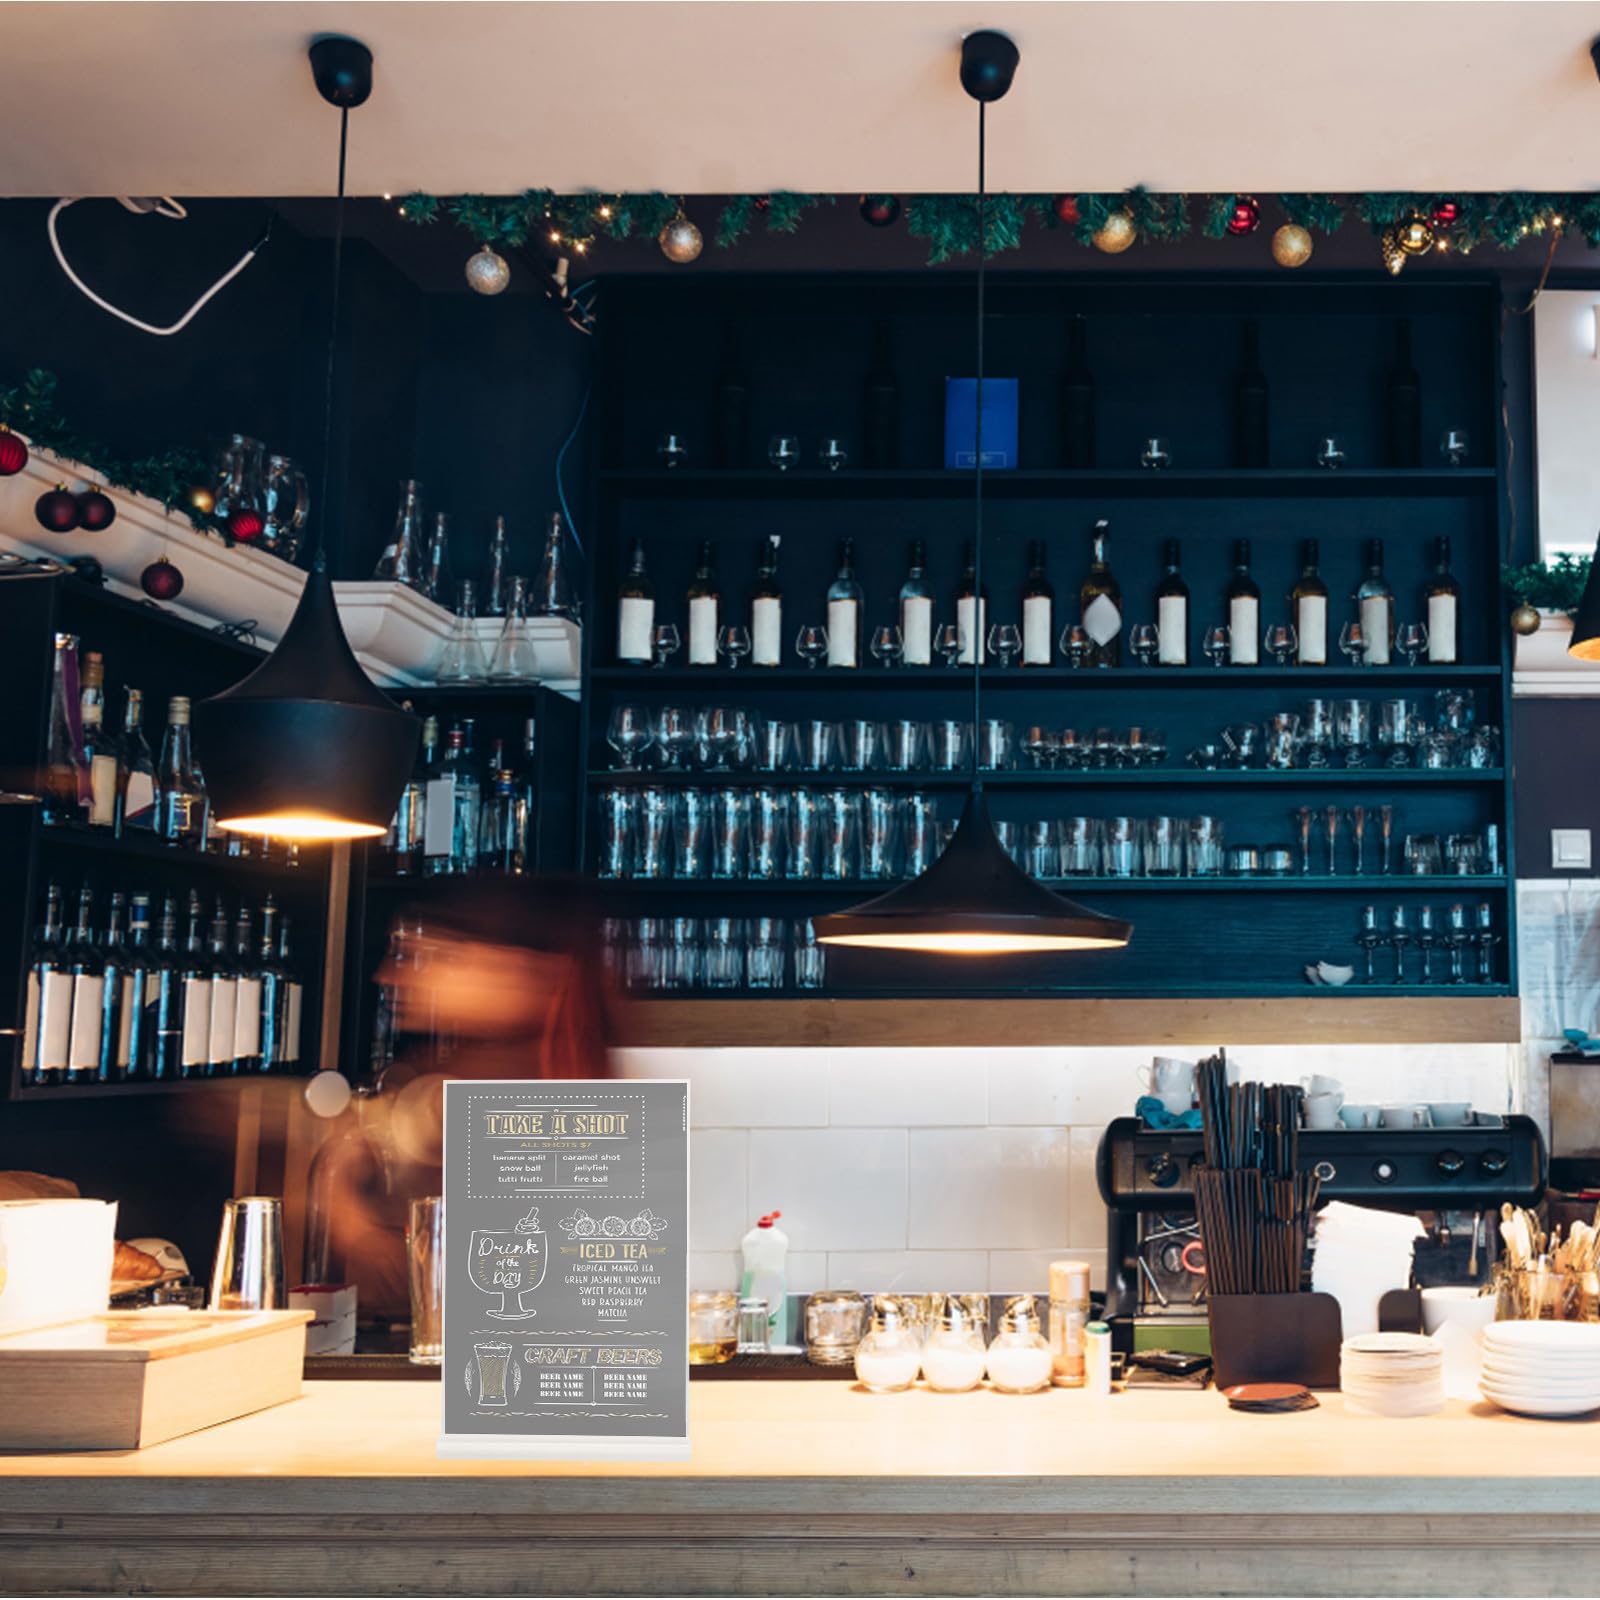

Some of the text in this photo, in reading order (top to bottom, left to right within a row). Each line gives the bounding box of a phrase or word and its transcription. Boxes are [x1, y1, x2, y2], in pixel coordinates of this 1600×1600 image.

[484, 1114, 629, 1135] TAKE A SHOT
[527, 1154, 546, 1162] split
[574, 1175, 608, 1183] fire ball
[478, 1237, 539, 1256] Drink
[579, 1244, 648, 1259] ICED TEA
[496, 1257, 519, 1270] of the
[572, 1264, 607, 1272] TROPICAL
[611, 1264, 639, 1272] MANGO
[564, 1276, 662, 1285] GREEN JASMINE UNSWEET
[579, 1287, 647, 1295] SWEET PEACH TEA
[581, 1298, 644, 1306] RED RASPBERRY
[598, 1309, 627, 1317] MATCHA
[524, 1348, 663, 1365] CRAFT BEERS
